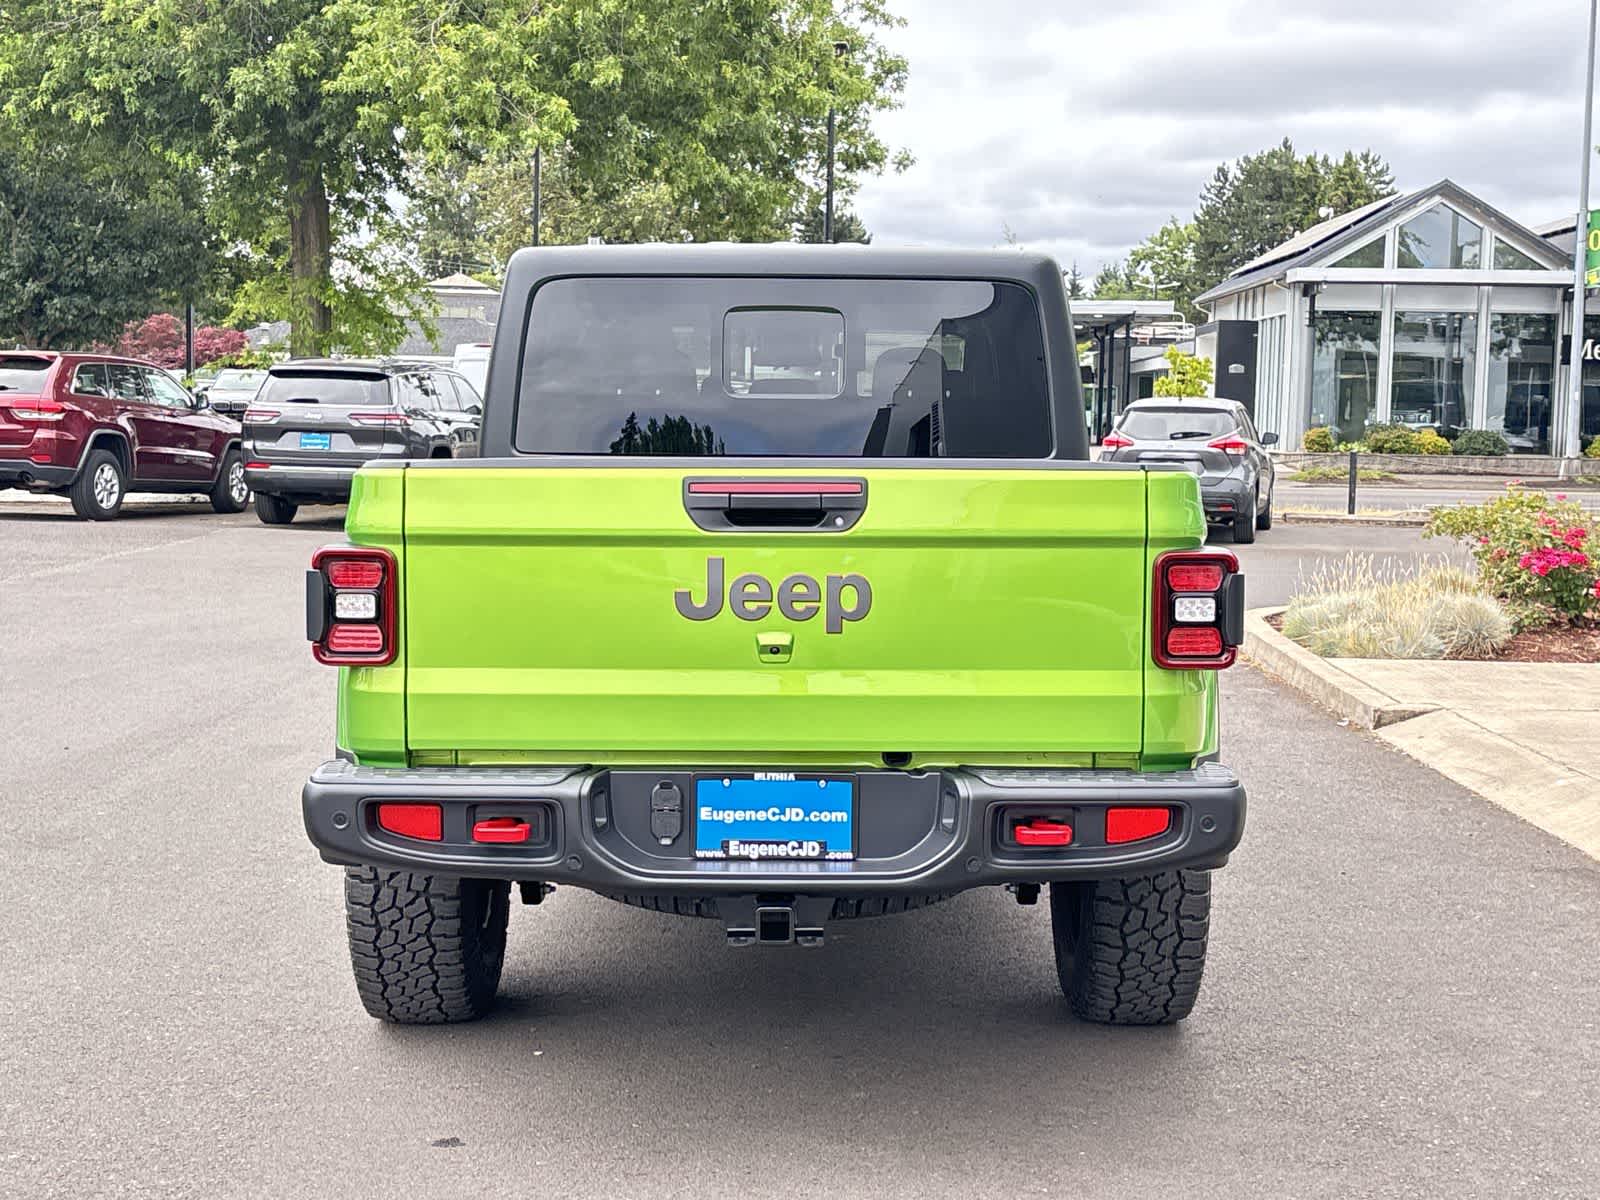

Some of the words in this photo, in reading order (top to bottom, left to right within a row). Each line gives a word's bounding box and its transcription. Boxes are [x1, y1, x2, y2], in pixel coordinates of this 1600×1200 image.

[674, 556, 873, 634] Jeep
[700, 807, 849, 824] EugeneCJD.com
[728, 840, 820, 859] EugeneCJD
